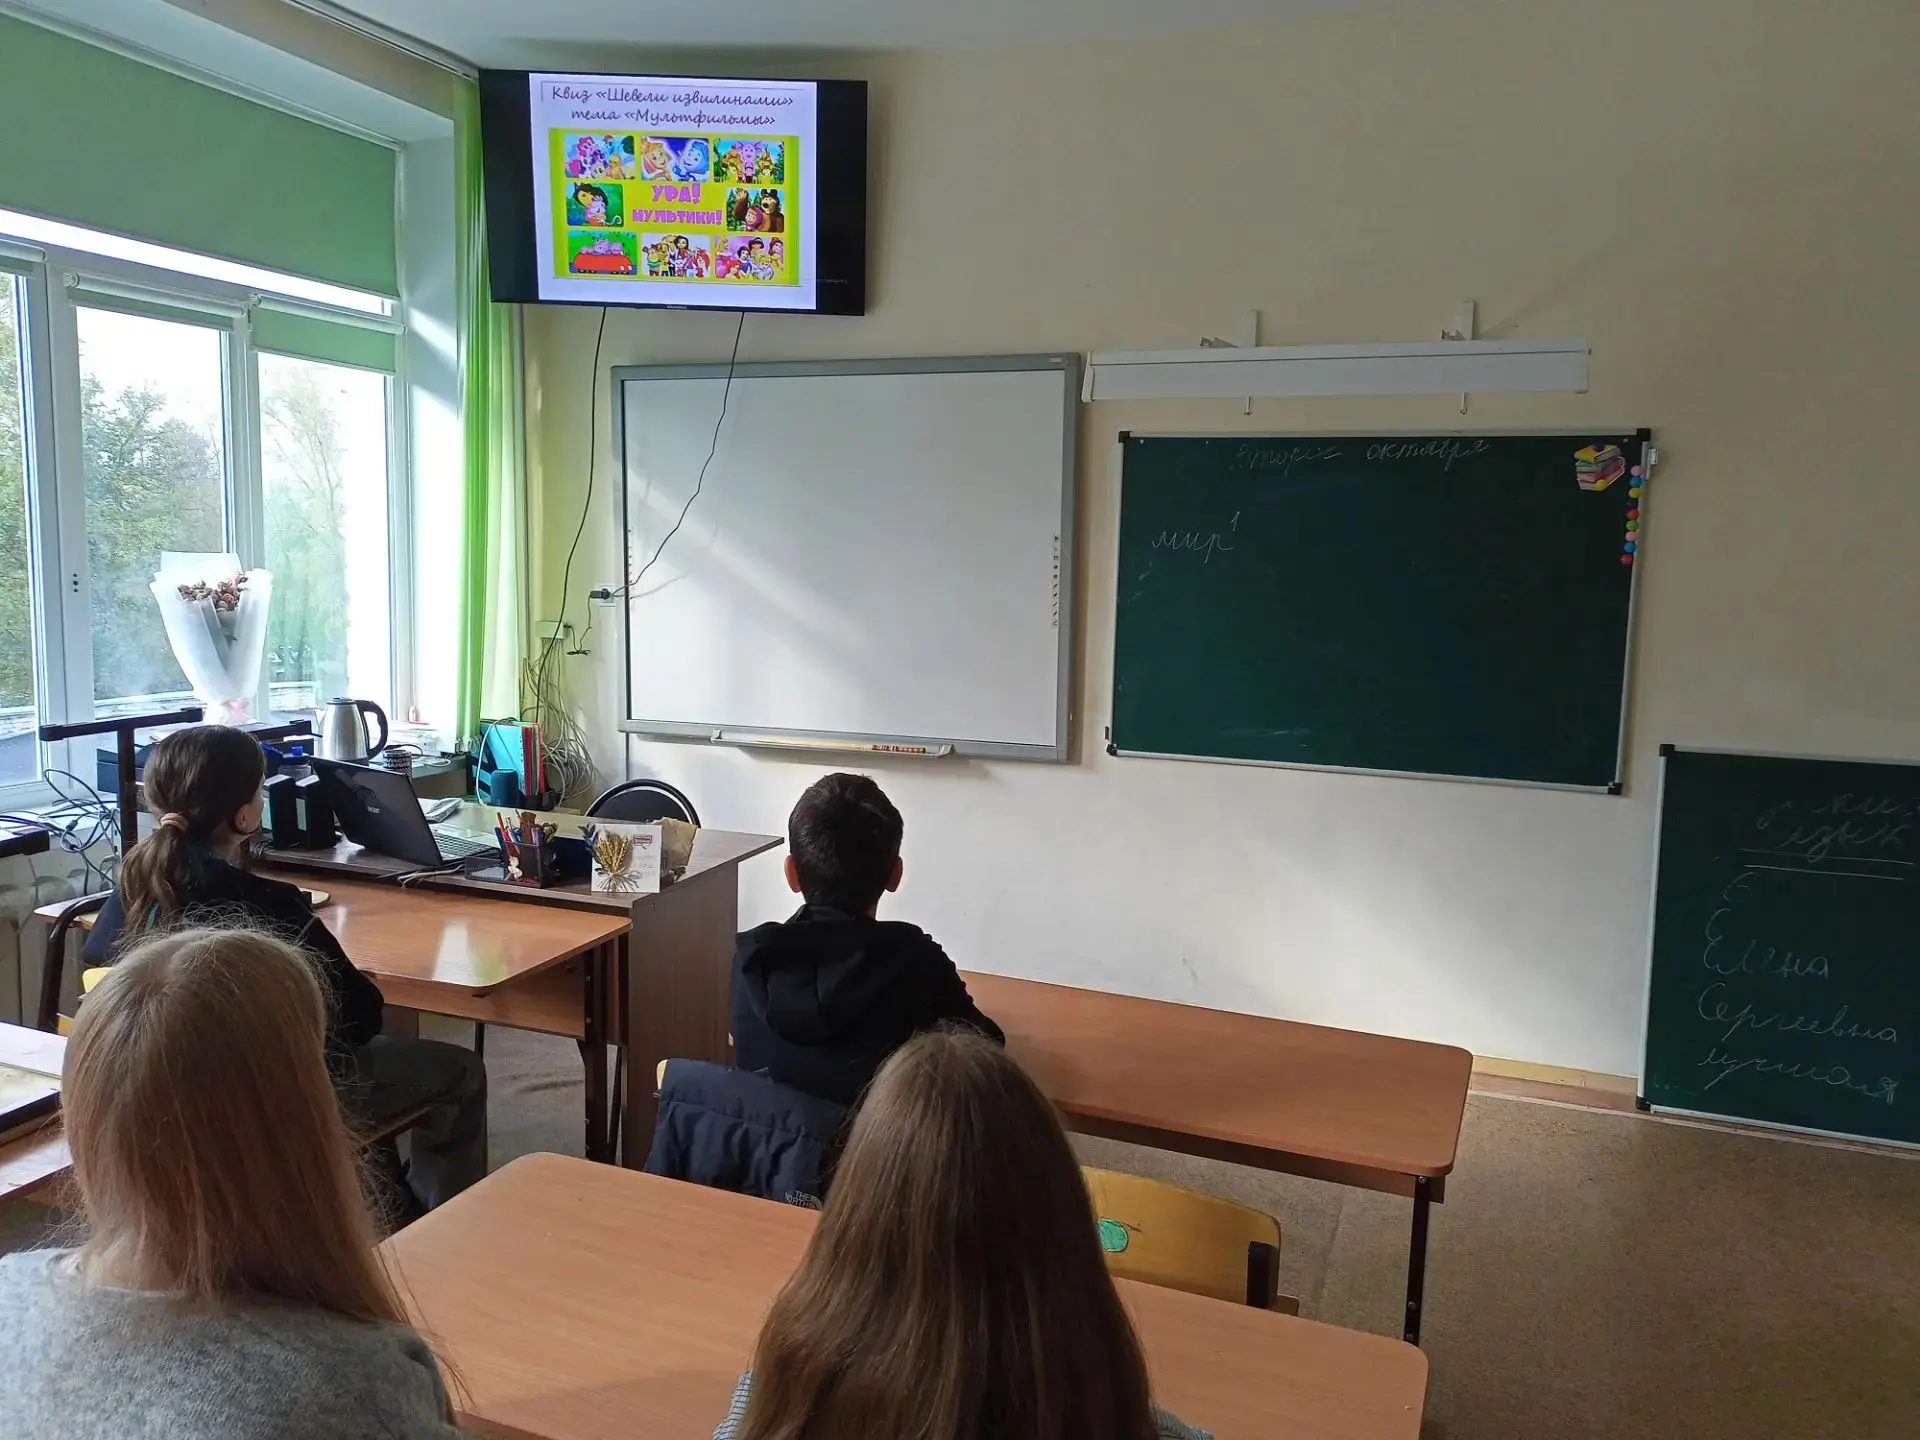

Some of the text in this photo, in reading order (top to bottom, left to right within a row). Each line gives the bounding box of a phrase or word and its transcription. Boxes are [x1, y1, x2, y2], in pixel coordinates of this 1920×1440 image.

[552, 85, 794, 107] Квиз «Шевели извилинами»
[571, 108, 776, 128] тема «Мультфильмы»
[651, 182, 701, 204] УРА!
[632, 208, 723, 226] МУЛЬТИКИ!
[795, 1190, 811, 1201] THE
